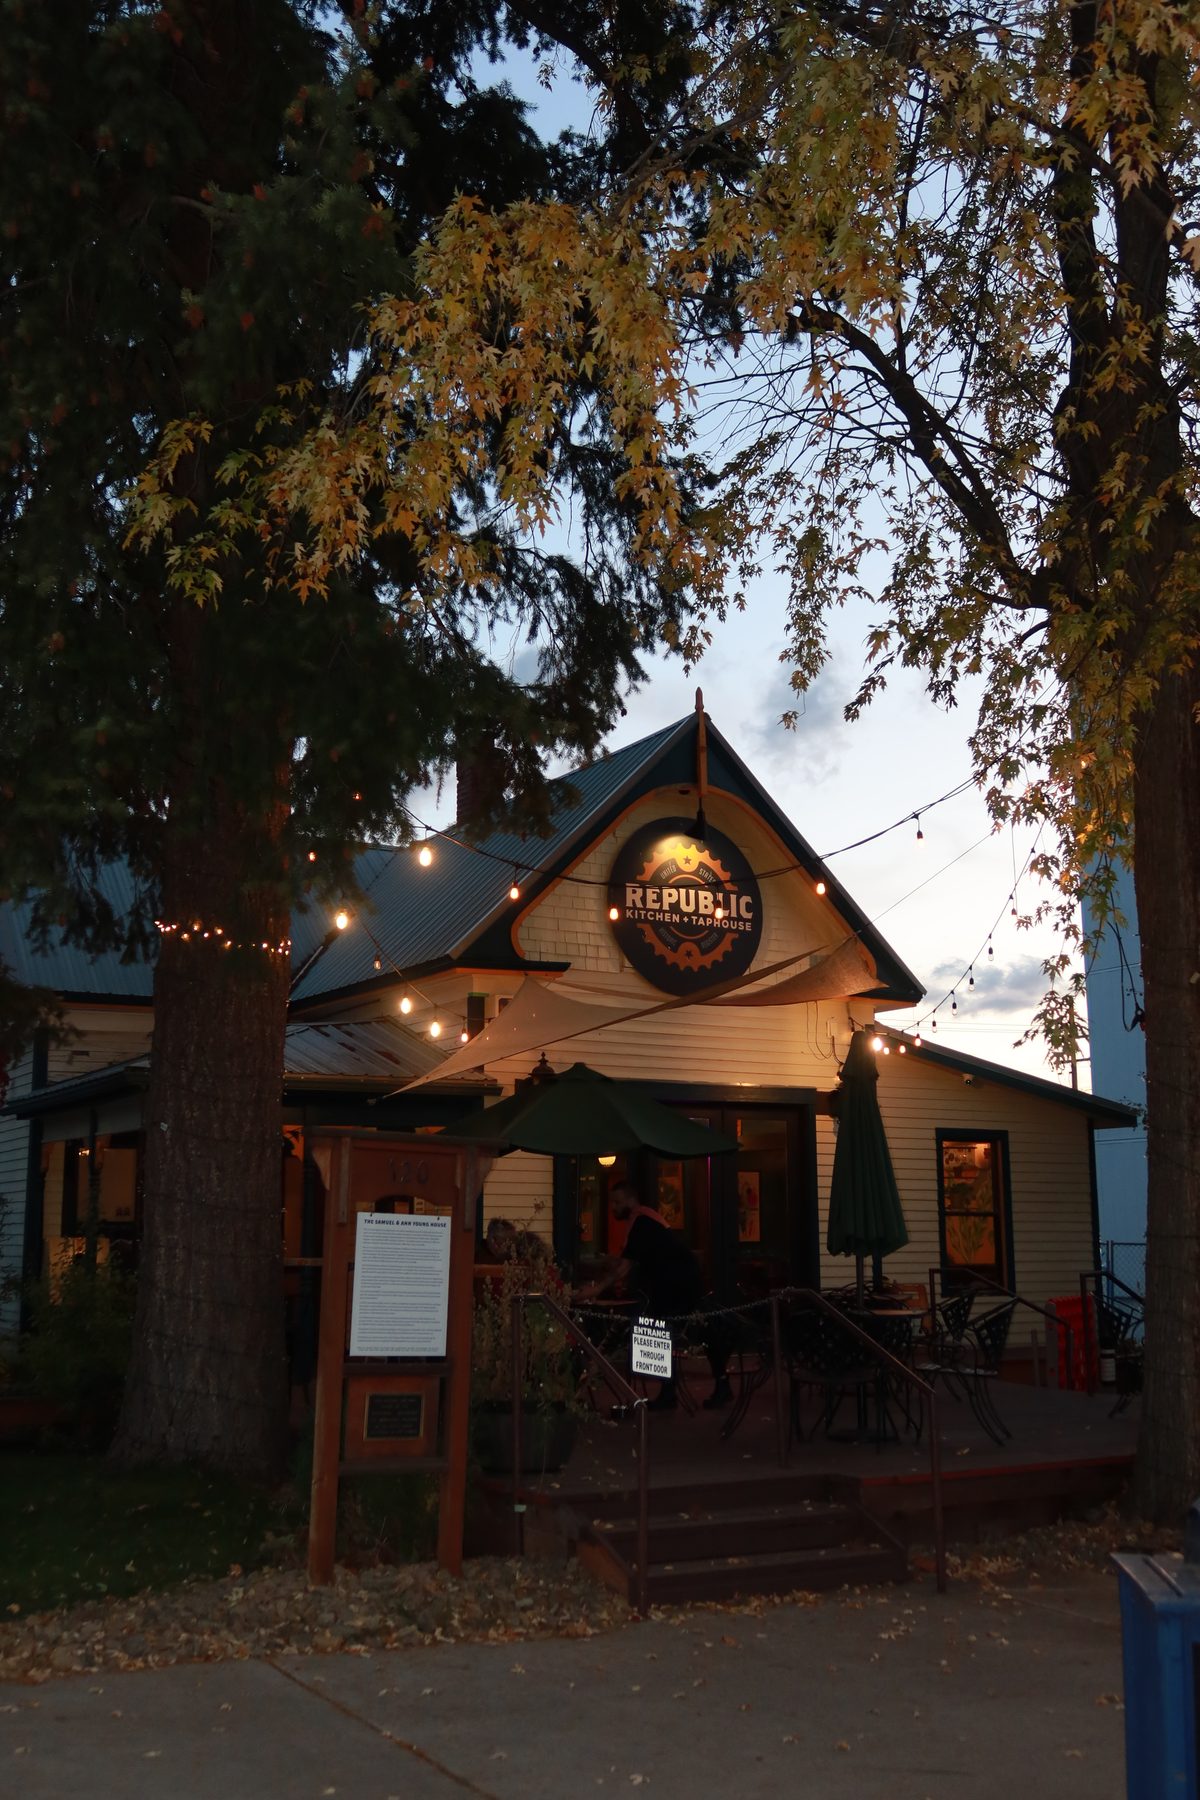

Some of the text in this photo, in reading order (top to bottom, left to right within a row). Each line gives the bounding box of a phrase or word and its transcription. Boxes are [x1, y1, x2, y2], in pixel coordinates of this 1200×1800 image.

[660, 864, 677, 880] UNITED
[625, 883, 753, 919] REPUBLIC
[626, 909, 680, 923] KITCHEN
[691, 916, 752, 931] TAPHOUSE
[639, 1316, 665, 1328] NOT AN
[634, 1326, 670, 1339] ENTRANCE
[634, 1337, 670, 1350] PLEASE ENTER
[640, 1350, 664, 1361] THROUGH
[636, 1361, 667, 1375] FRONT DOOR
